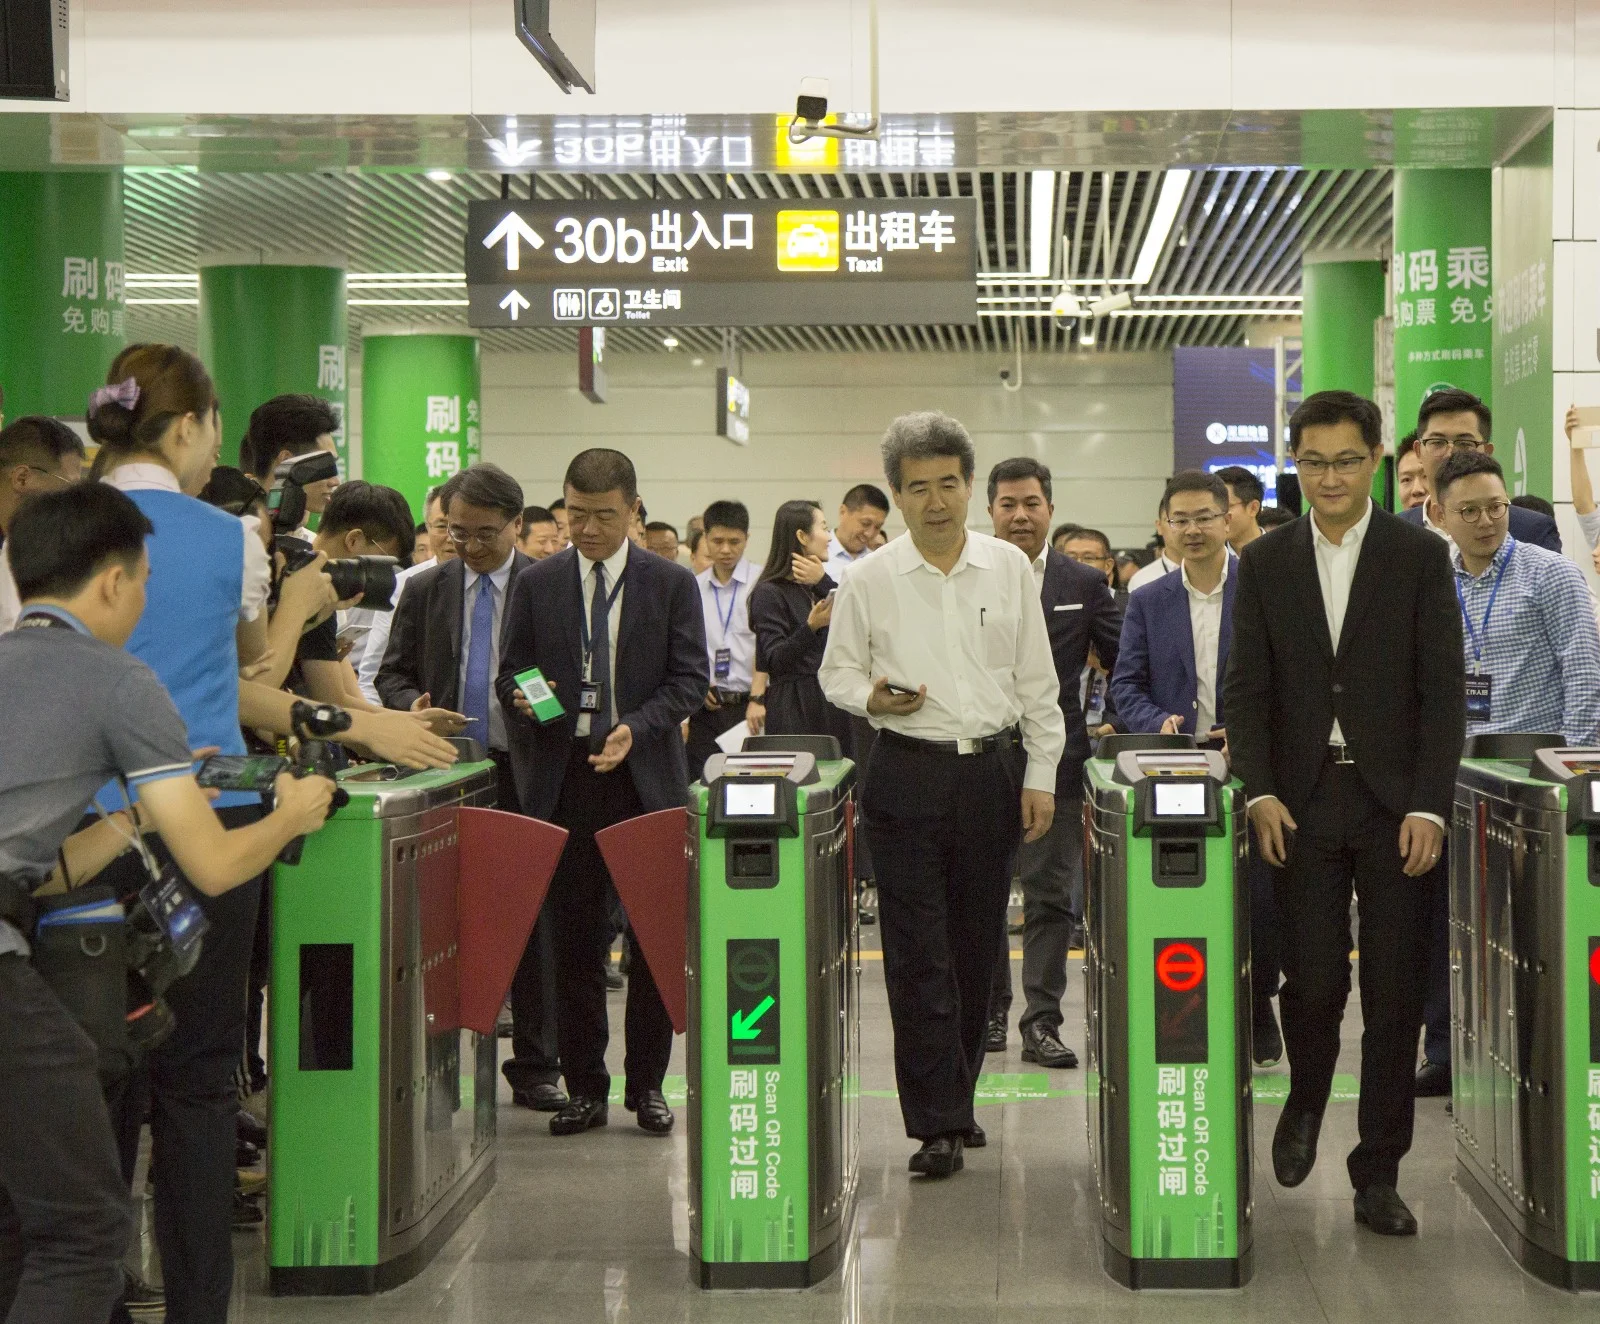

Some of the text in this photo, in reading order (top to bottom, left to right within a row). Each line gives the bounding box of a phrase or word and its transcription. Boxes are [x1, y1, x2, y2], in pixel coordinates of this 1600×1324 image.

[554, 209, 956, 264] 30b 出入口 出租车
[652, 256, 689, 273] Exit
[845, 256, 883, 273] Taxi
[623, 288, 681, 310] 卫生间
[425, 395, 461, 498] 刷码
[729, 1069, 759, 1200] 刷码过闸
[765, 1071, 780, 1199] Scan QR Code
[1157, 1066, 1188, 1196] 刷码过闸
[1193, 1068, 1209, 1196] Scan QR Code
